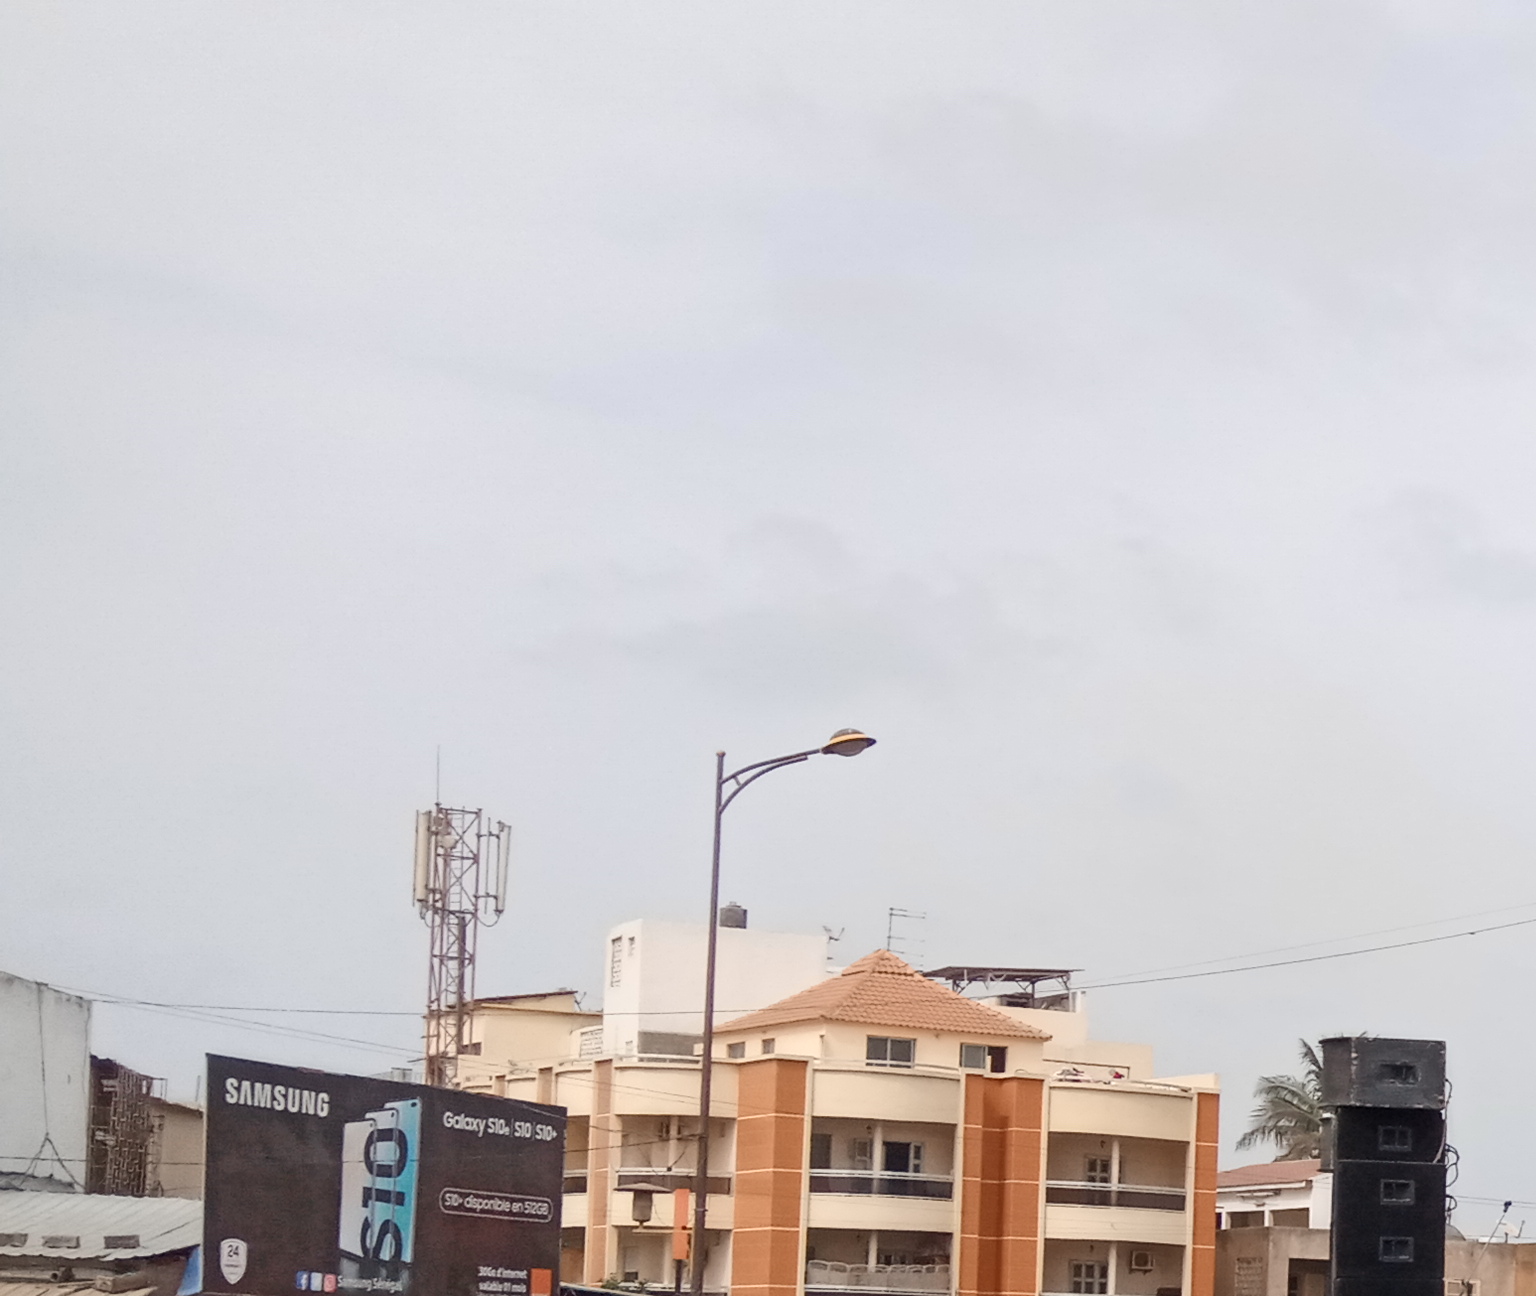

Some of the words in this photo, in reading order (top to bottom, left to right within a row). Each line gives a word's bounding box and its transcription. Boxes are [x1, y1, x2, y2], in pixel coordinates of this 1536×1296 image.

[225, 1077, 330, 1118] SAMSUNG
[443, 1111, 486, 1137] Galaxy
[487, 1118, 510, 1135] S10e
[514, 1121, 531, 1138] S10
[535, 1123, 557, 1141] S10+
[361, 1128, 408, 1263] S10
[464, 1195, 510, 1212] disponible
[511, 1202, 523, 1213] en
